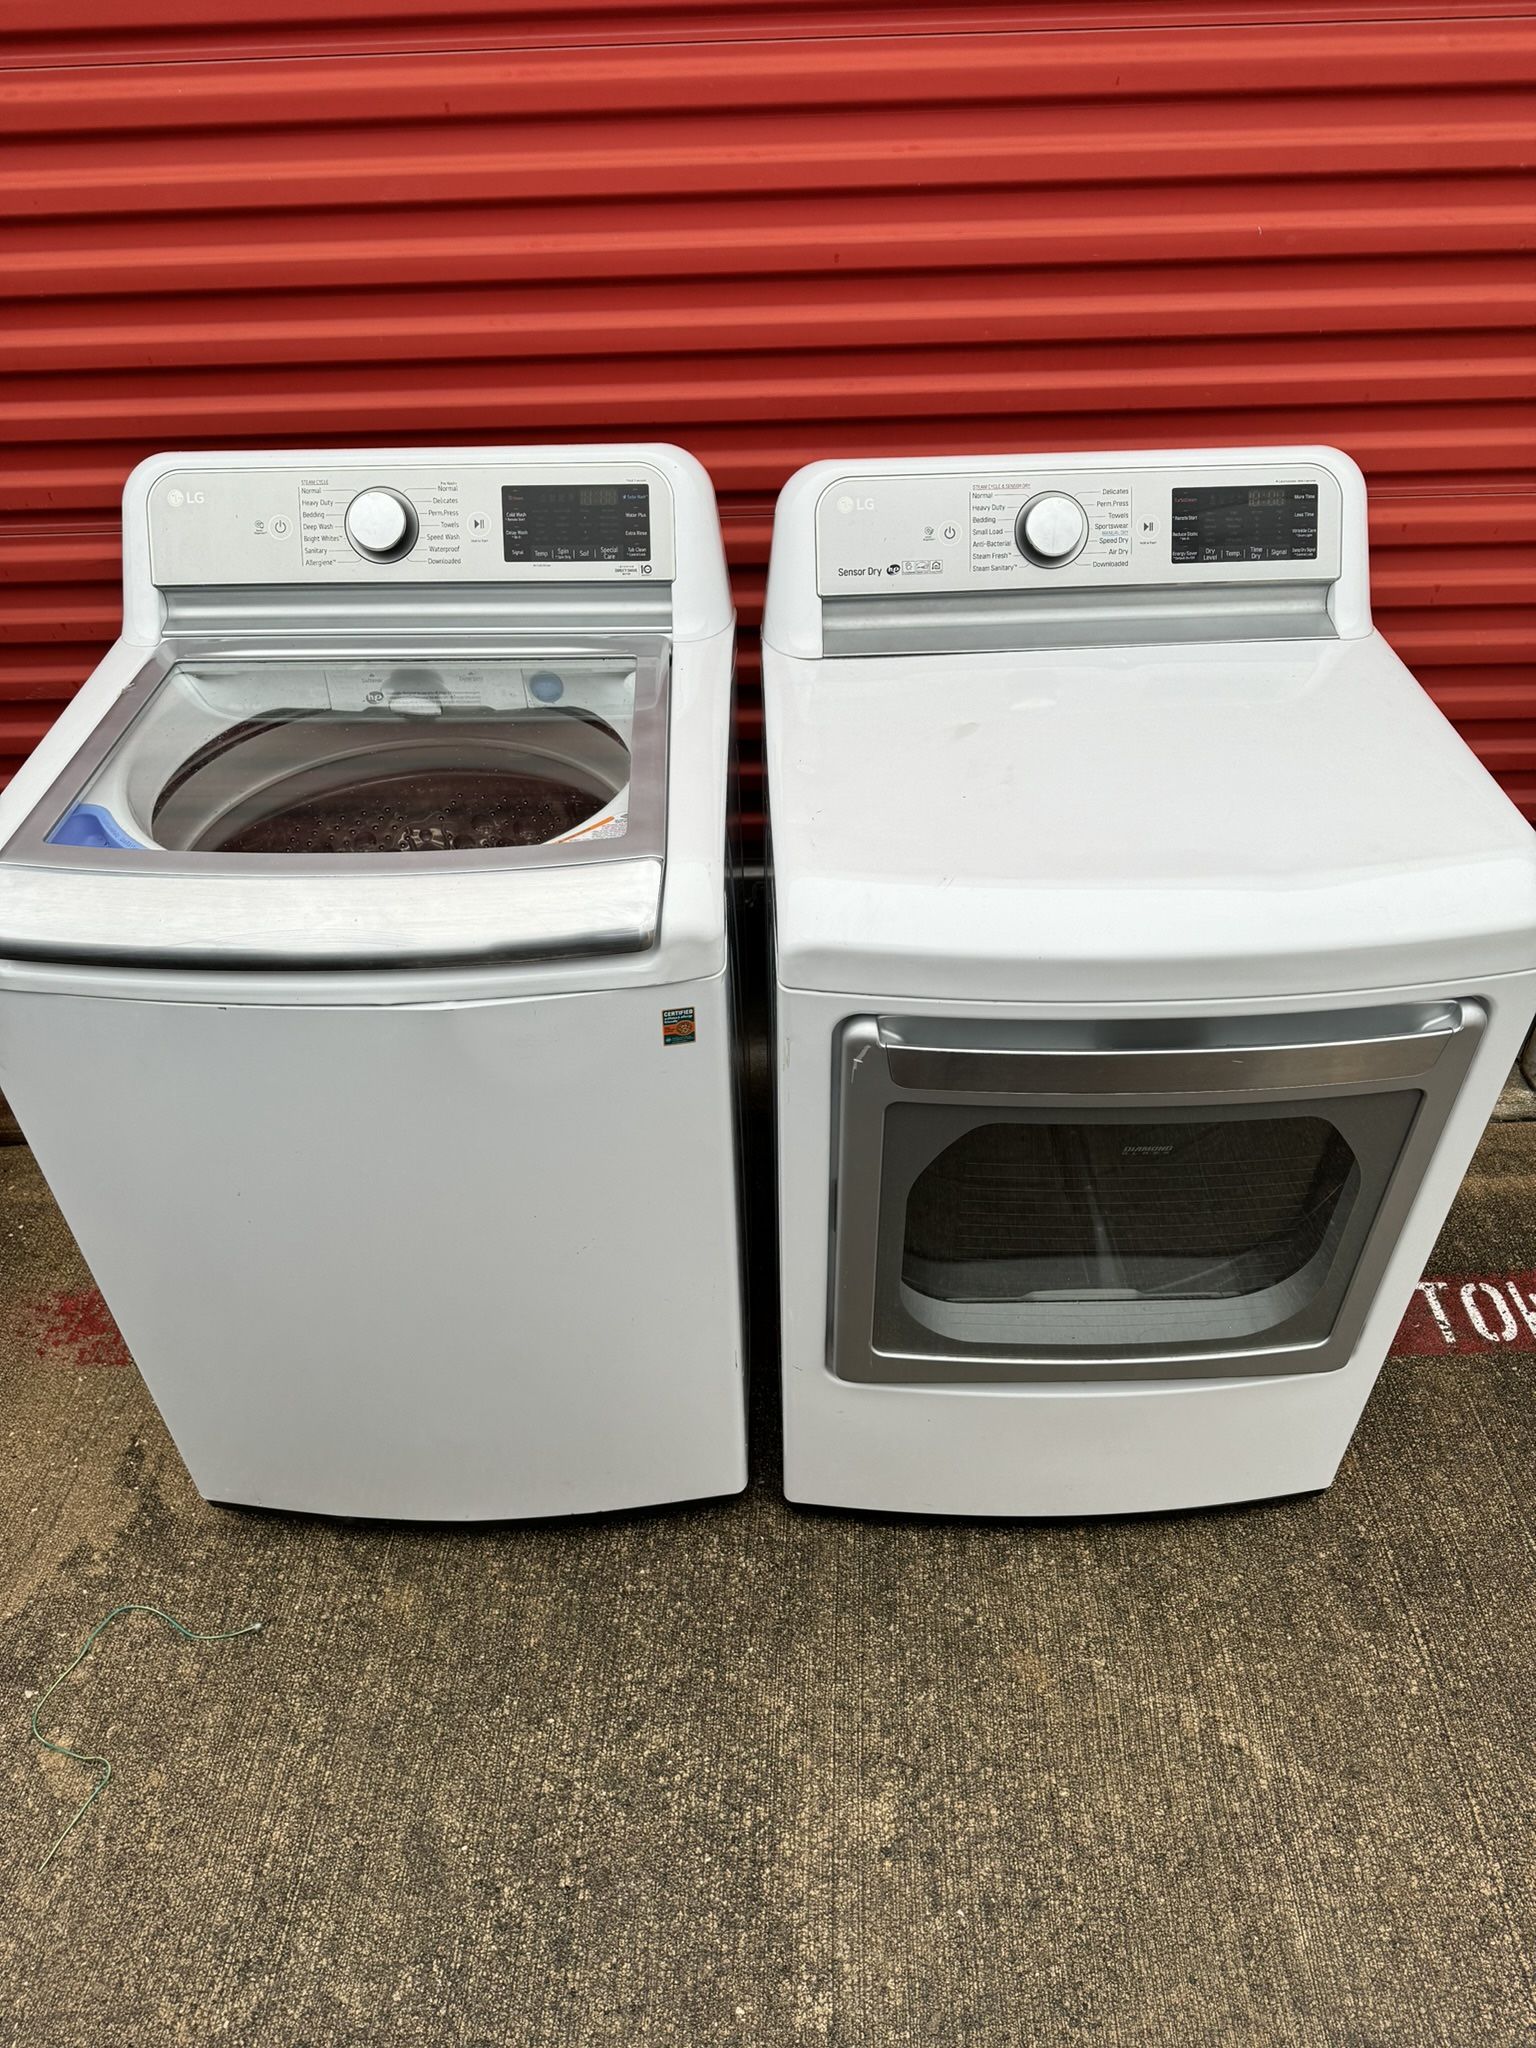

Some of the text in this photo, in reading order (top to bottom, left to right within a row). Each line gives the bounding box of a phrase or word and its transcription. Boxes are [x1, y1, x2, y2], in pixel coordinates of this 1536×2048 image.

[186, 492, 204, 504] LG
[856, 498, 875, 510] LG
[303, 535, 320, 543] Bright
[426, 534, 444, 542] Speed
[1118, 536, 1129, 544] Dry
[304, 547, 327, 555] Sanitary
[557, 547, 570, 555] Spin
[600, 546, 618, 554] Special
[1271, 549, 1288, 557] Signal
[838, 567, 882, 577] Sensor Dry
[663, 1009, 693, 1017] CERTIFIED
